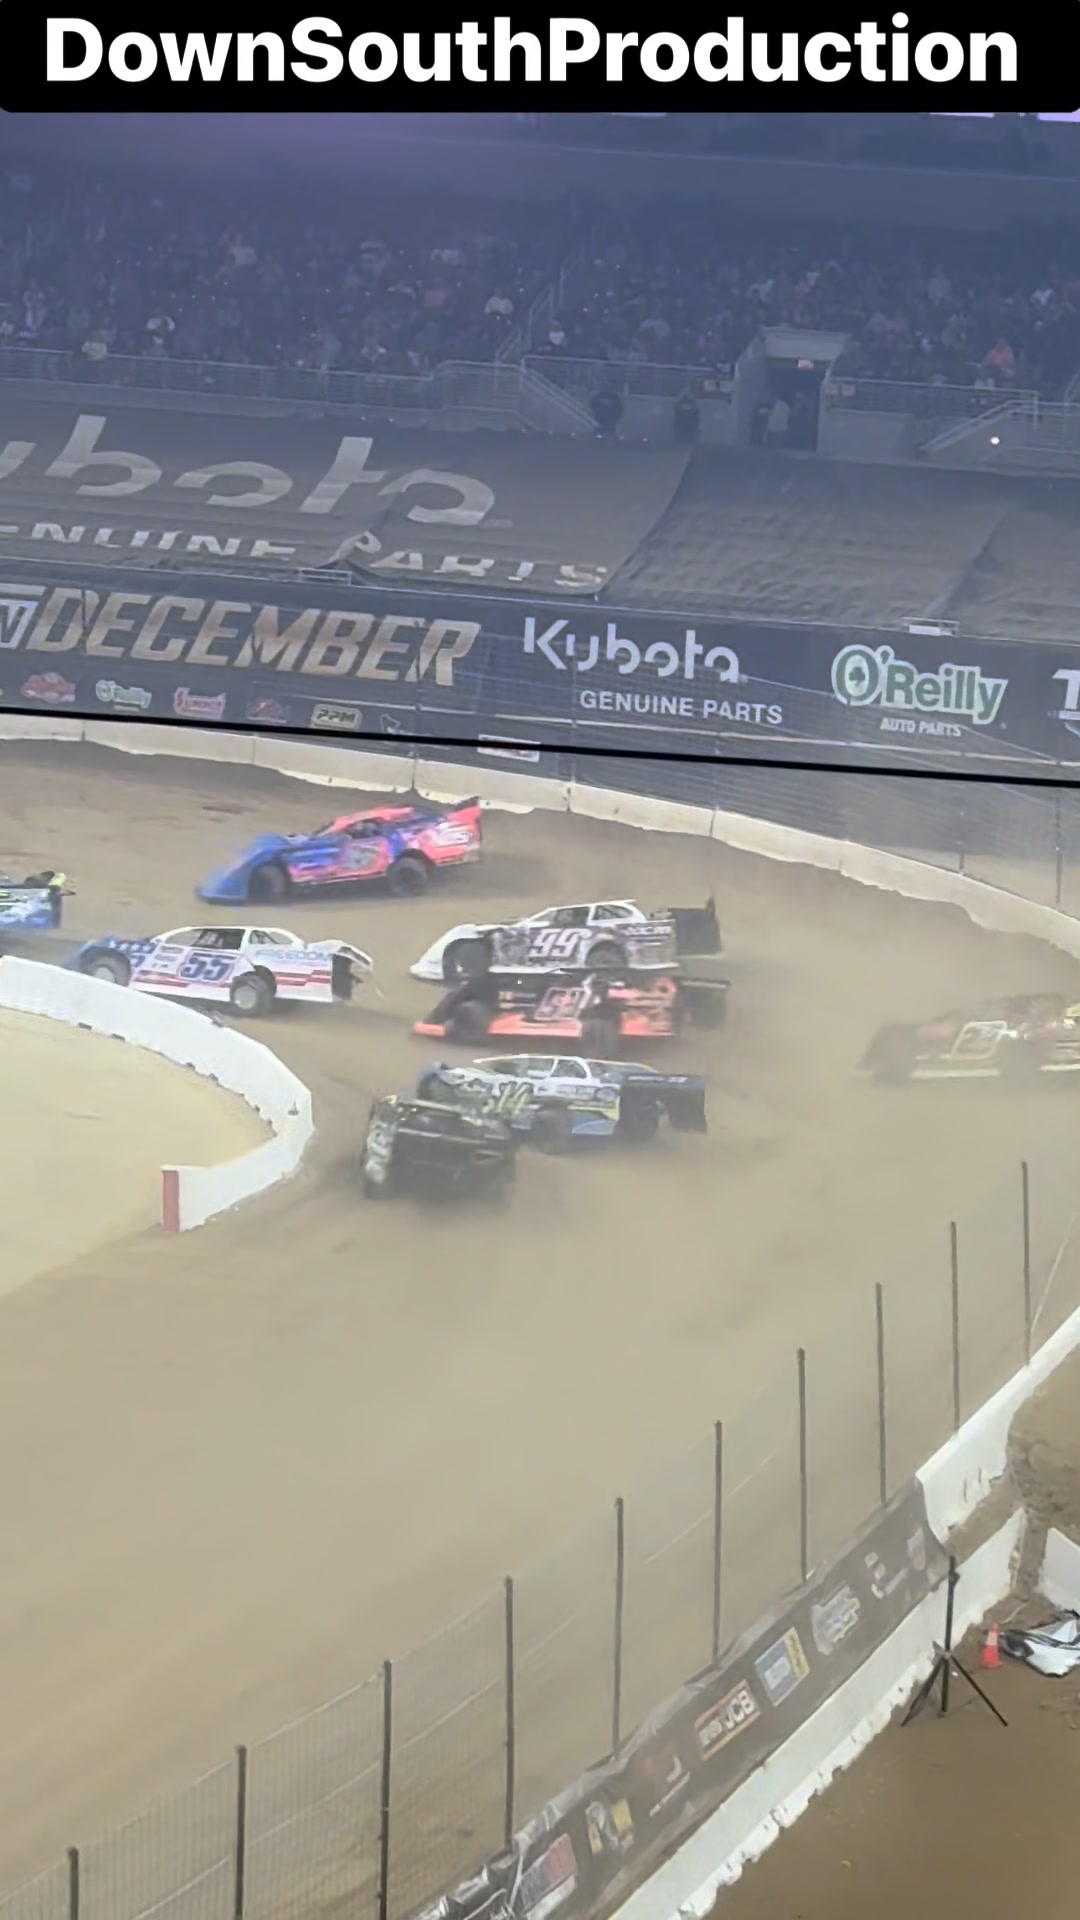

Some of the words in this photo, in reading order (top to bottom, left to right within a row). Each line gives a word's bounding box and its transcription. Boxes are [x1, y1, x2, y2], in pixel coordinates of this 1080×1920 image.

[26, 587, 481, 686] DECEMBER
[523, 617, 740, 683] Kubota
[831, 644, 1008, 725] O'Reilly
[580, 690, 693, 717] GENUINE
[703, 699, 783, 725] PARTS
[880, 717, 916, 733] AUTO
[918, 721, 962, 737] PARTS
[181, 952, 232, 979] 55
[723, 1690, 755, 1730] JCB
